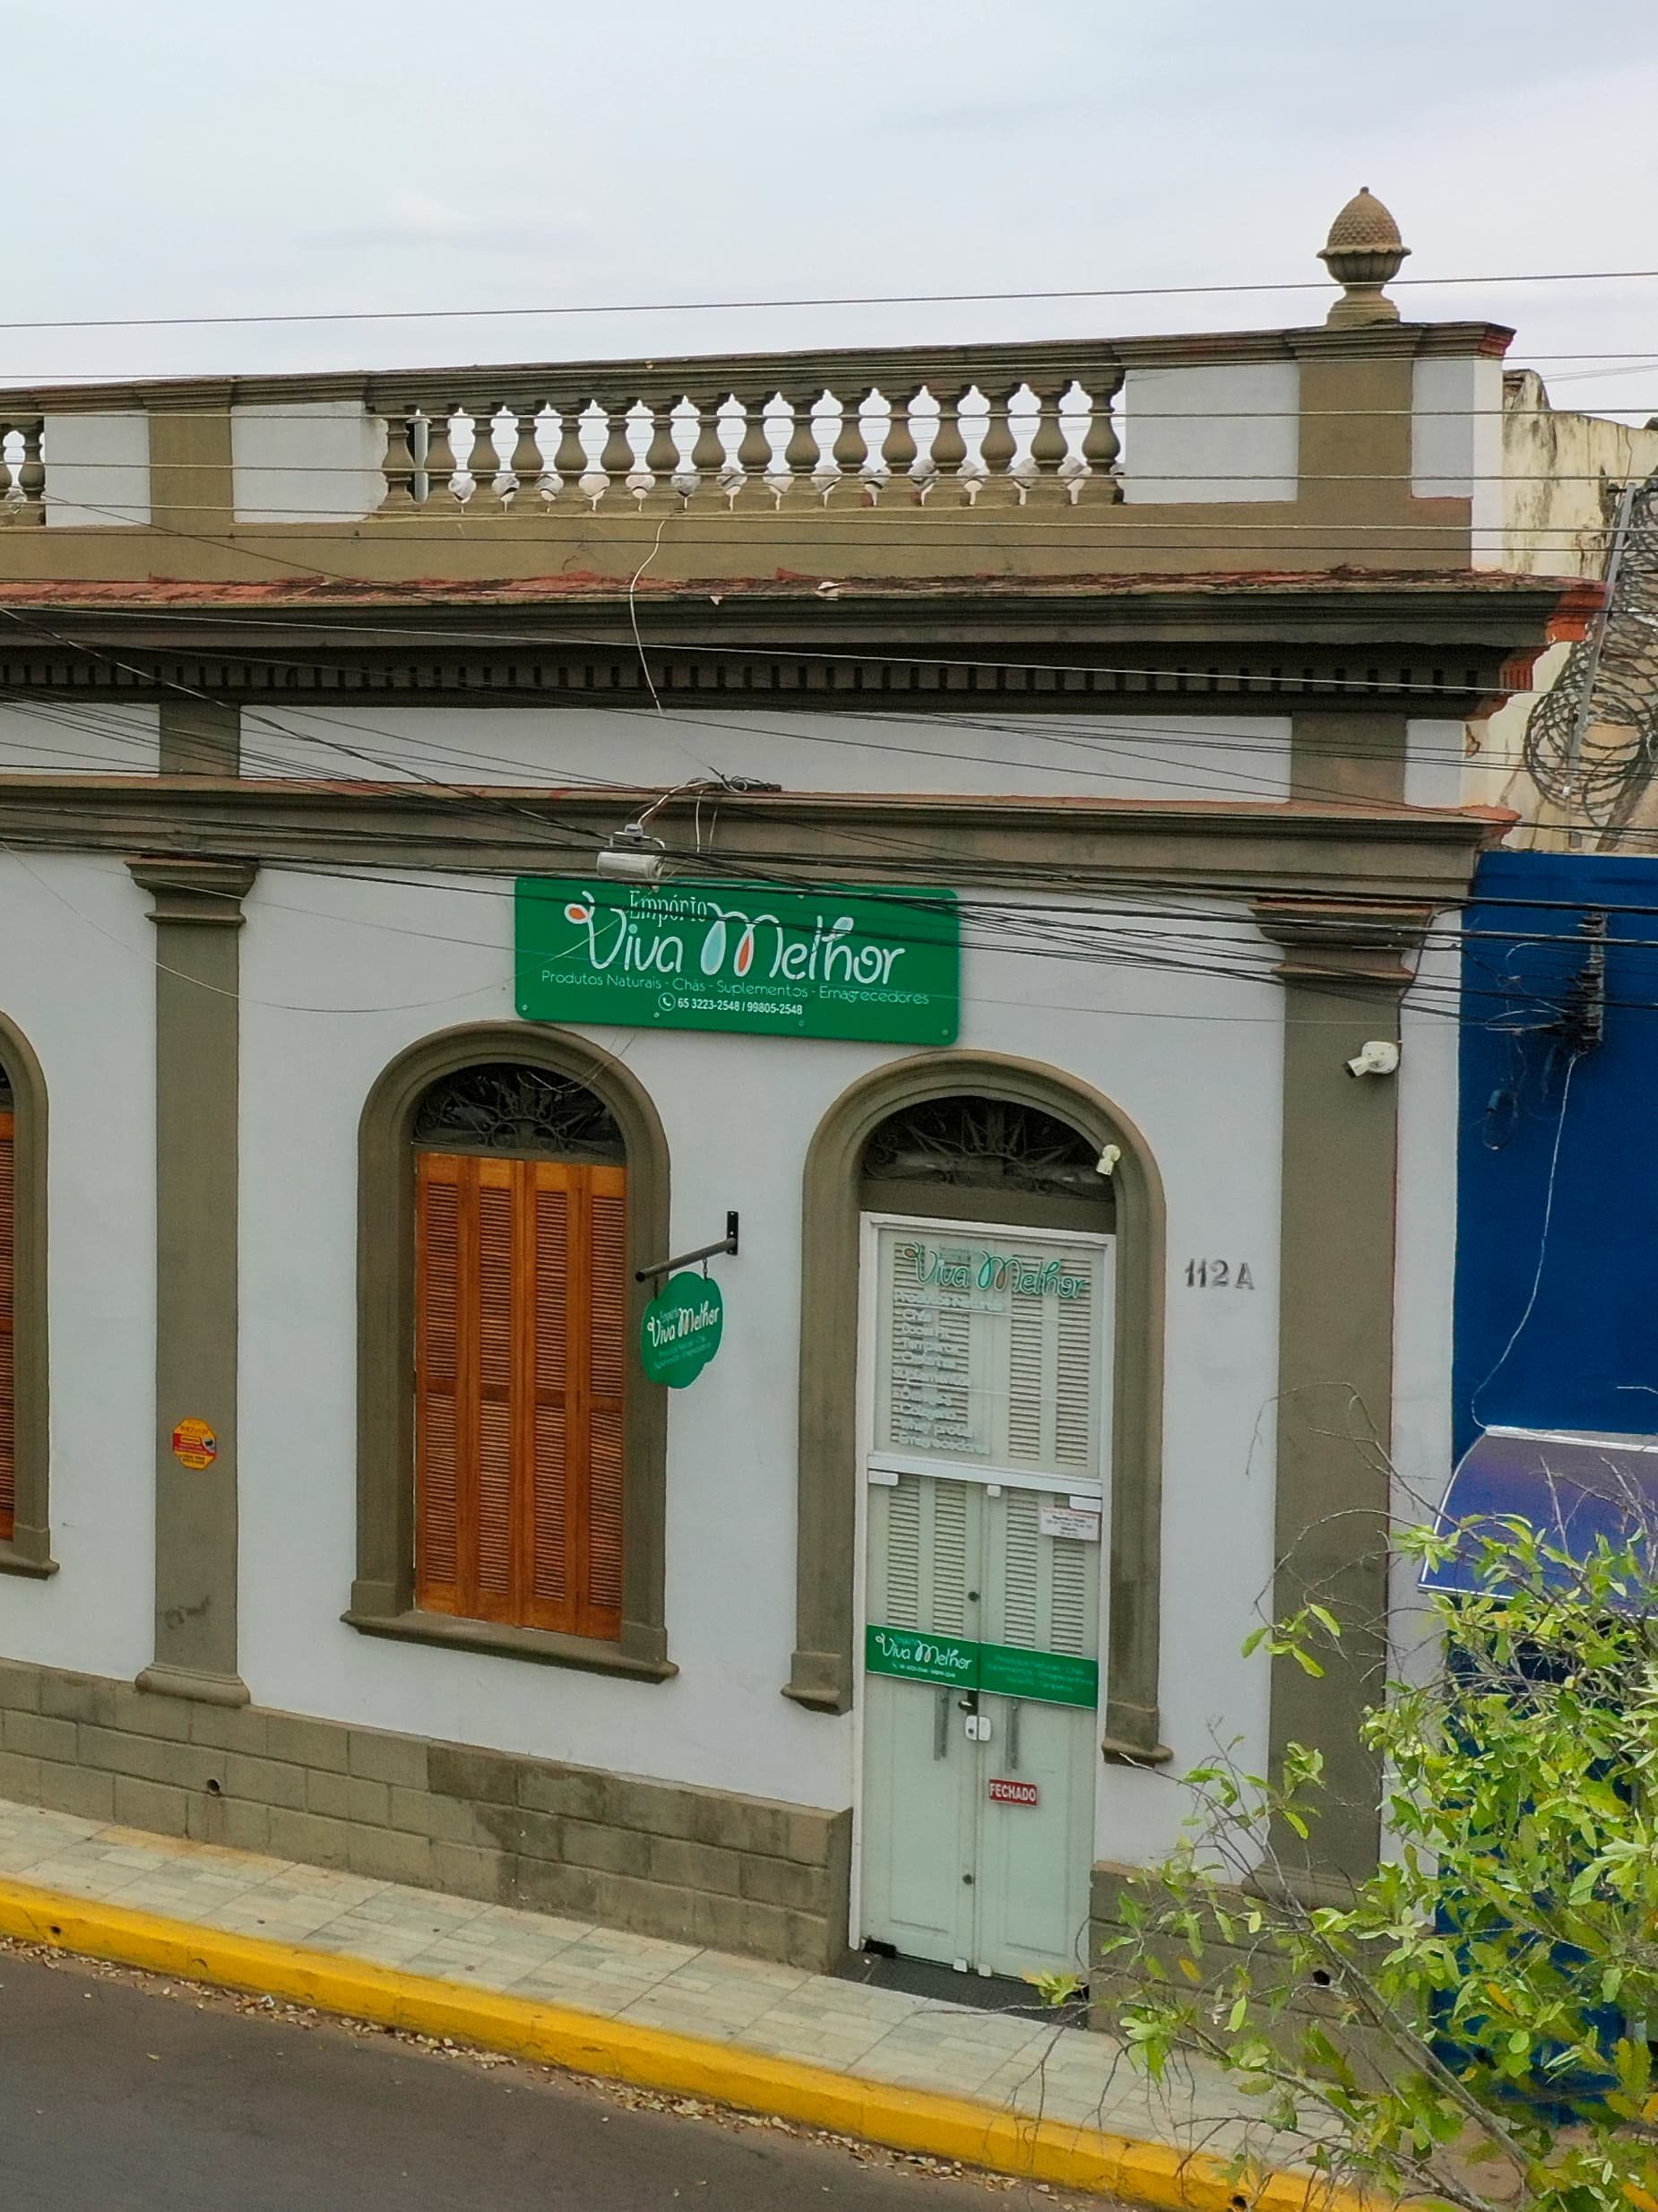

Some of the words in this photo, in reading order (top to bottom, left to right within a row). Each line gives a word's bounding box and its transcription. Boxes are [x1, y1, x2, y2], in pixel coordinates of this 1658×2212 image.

[629, 890, 707, 928] Empório
[564, 891, 684, 973] Viva
[701, 901, 906, 985] Melhor
[541, 970, 603, 986] Produtos
[607, 974, 661, 989] Naturais
[673, 977, 705, 992] Chás
[717, 980, 807, 997] Suplementos
[819, 986, 929, 1005] Emagrecedores
[678, 998, 689, 1008] 65
[691, 998, 740, 1011] 3223-2548
[747, 1001, 803, 1015] 99805-2548
[902, 1241, 969, 1288] Viva
[975, 1249, 1085, 1298] Melhor
[647, 1316, 676, 1347] Viva
[678, 1300, 720, 1337] Melhor
[875, 1632, 911, 1660] Viva
[914, 1640, 972, 1670] Melhor
[989, 1784, 1036, 1802] FECHADO
